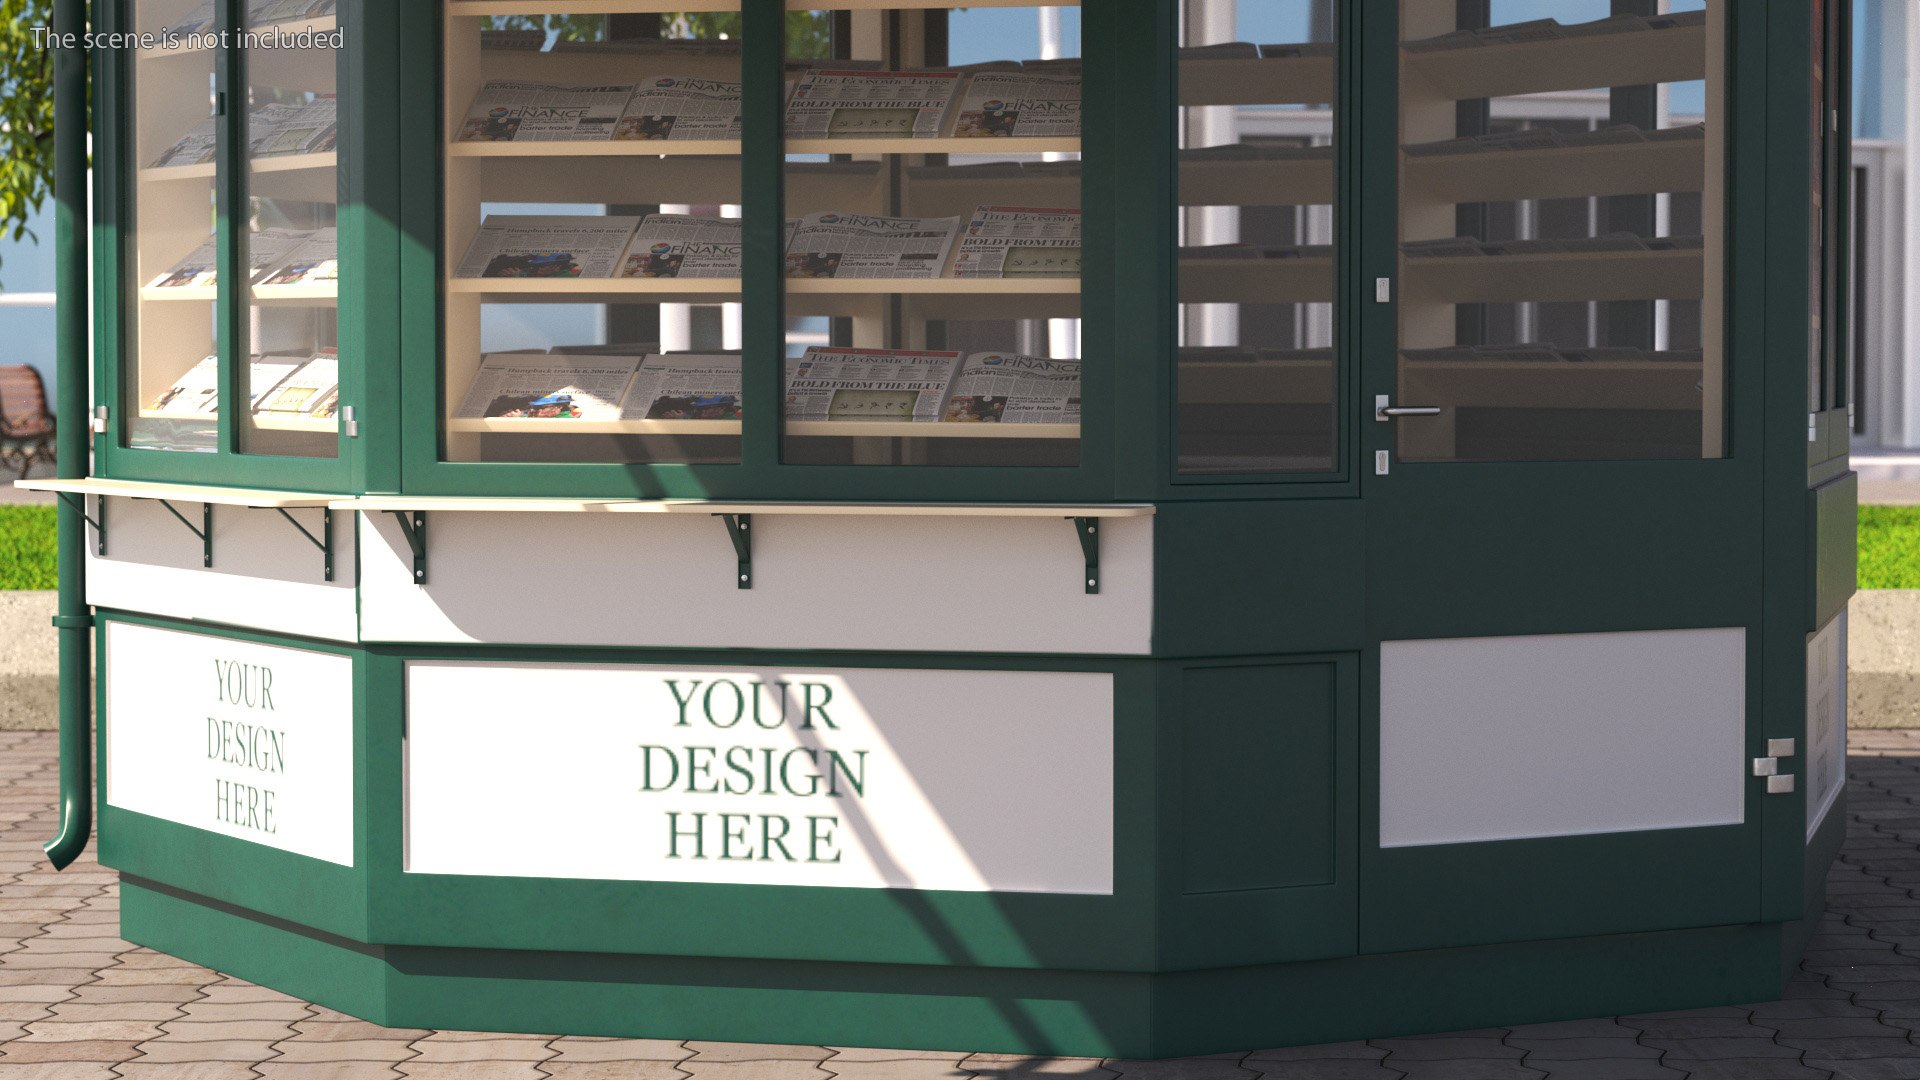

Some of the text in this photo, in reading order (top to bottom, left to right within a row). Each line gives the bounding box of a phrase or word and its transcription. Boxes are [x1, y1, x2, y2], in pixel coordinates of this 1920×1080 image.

[675, 80, 741, 92] FINANC
[1004, 101, 1081, 110] FINANC
[509, 110, 589, 118] FINANCE
[981, 212, 1009, 220] THE
[840, 217, 919, 229] FINANCE
[671, 246, 741, 254] FINANC
[810, 353, 950, 365] THE ECONOMIC TIMES
[831, 381, 872, 389] FROM
[907, 382, 945, 390] BLUE
[215, 659, 274, 710] YOUR
[663, 679, 840, 730] YOUR
[207, 717, 285, 775] DESIGN
[638, 745, 869, 798] DESIGN
[216, 779, 276, 834] HERE
[665, 812, 842, 864] HERE
